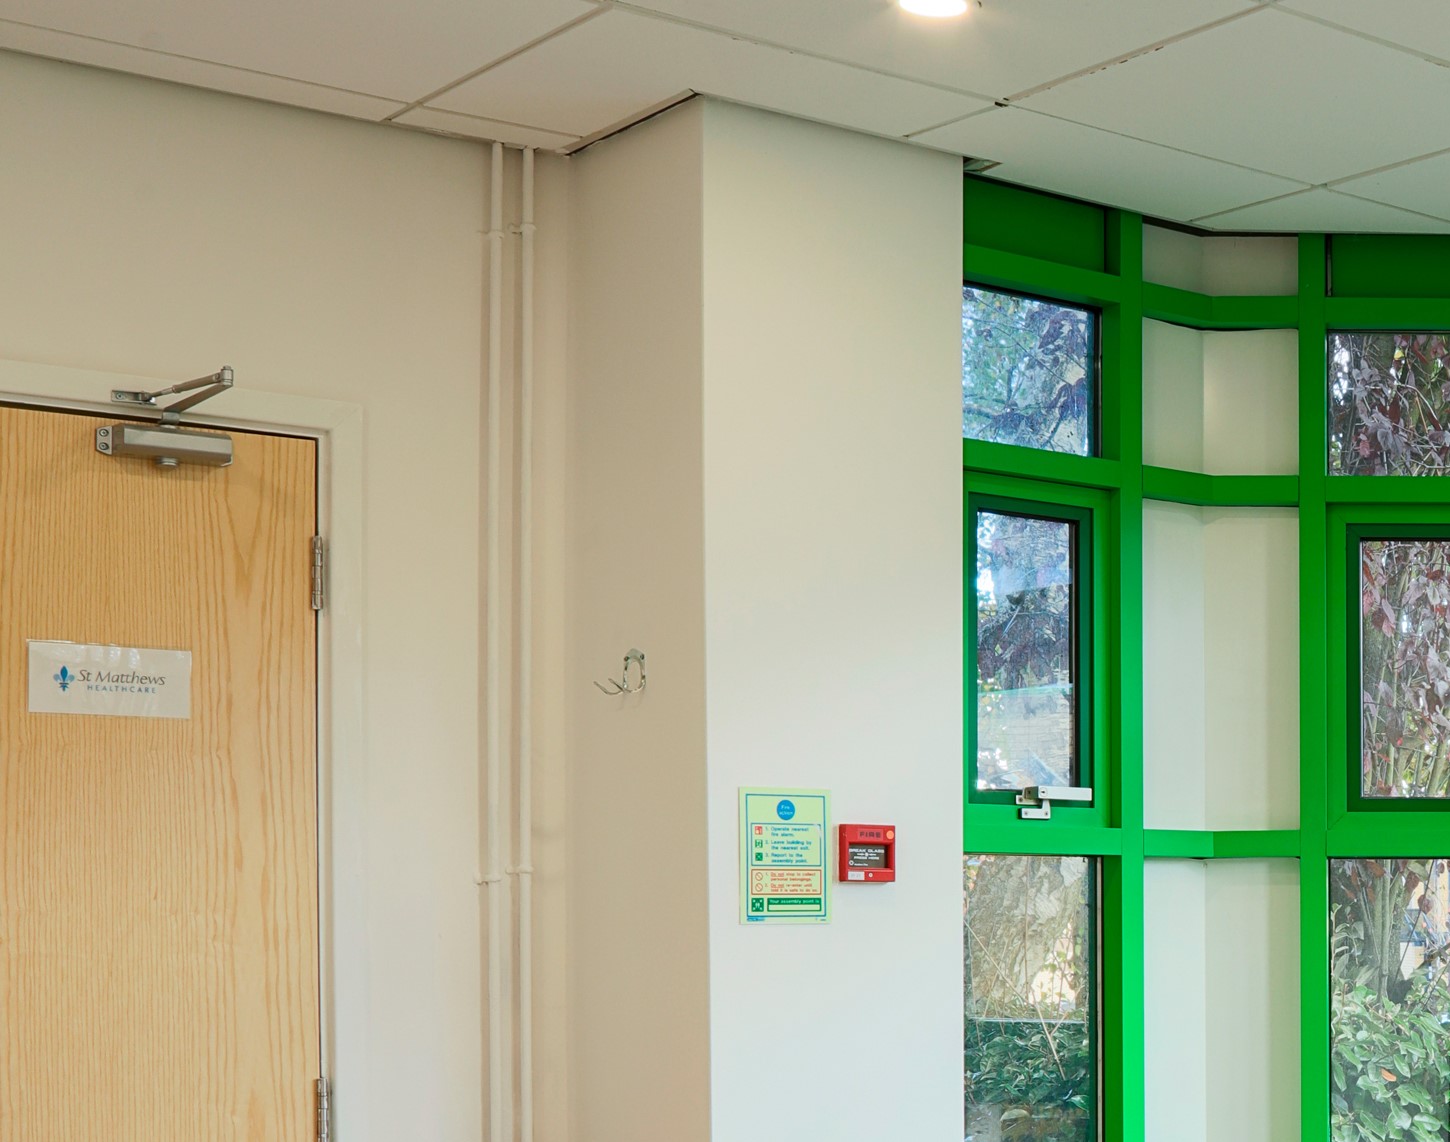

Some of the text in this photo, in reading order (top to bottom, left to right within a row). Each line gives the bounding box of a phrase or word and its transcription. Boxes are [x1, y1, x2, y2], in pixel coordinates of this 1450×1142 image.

[77, 670, 166, 686] St Matthews
[87, 685, 156, 694] HEALTHCARE
